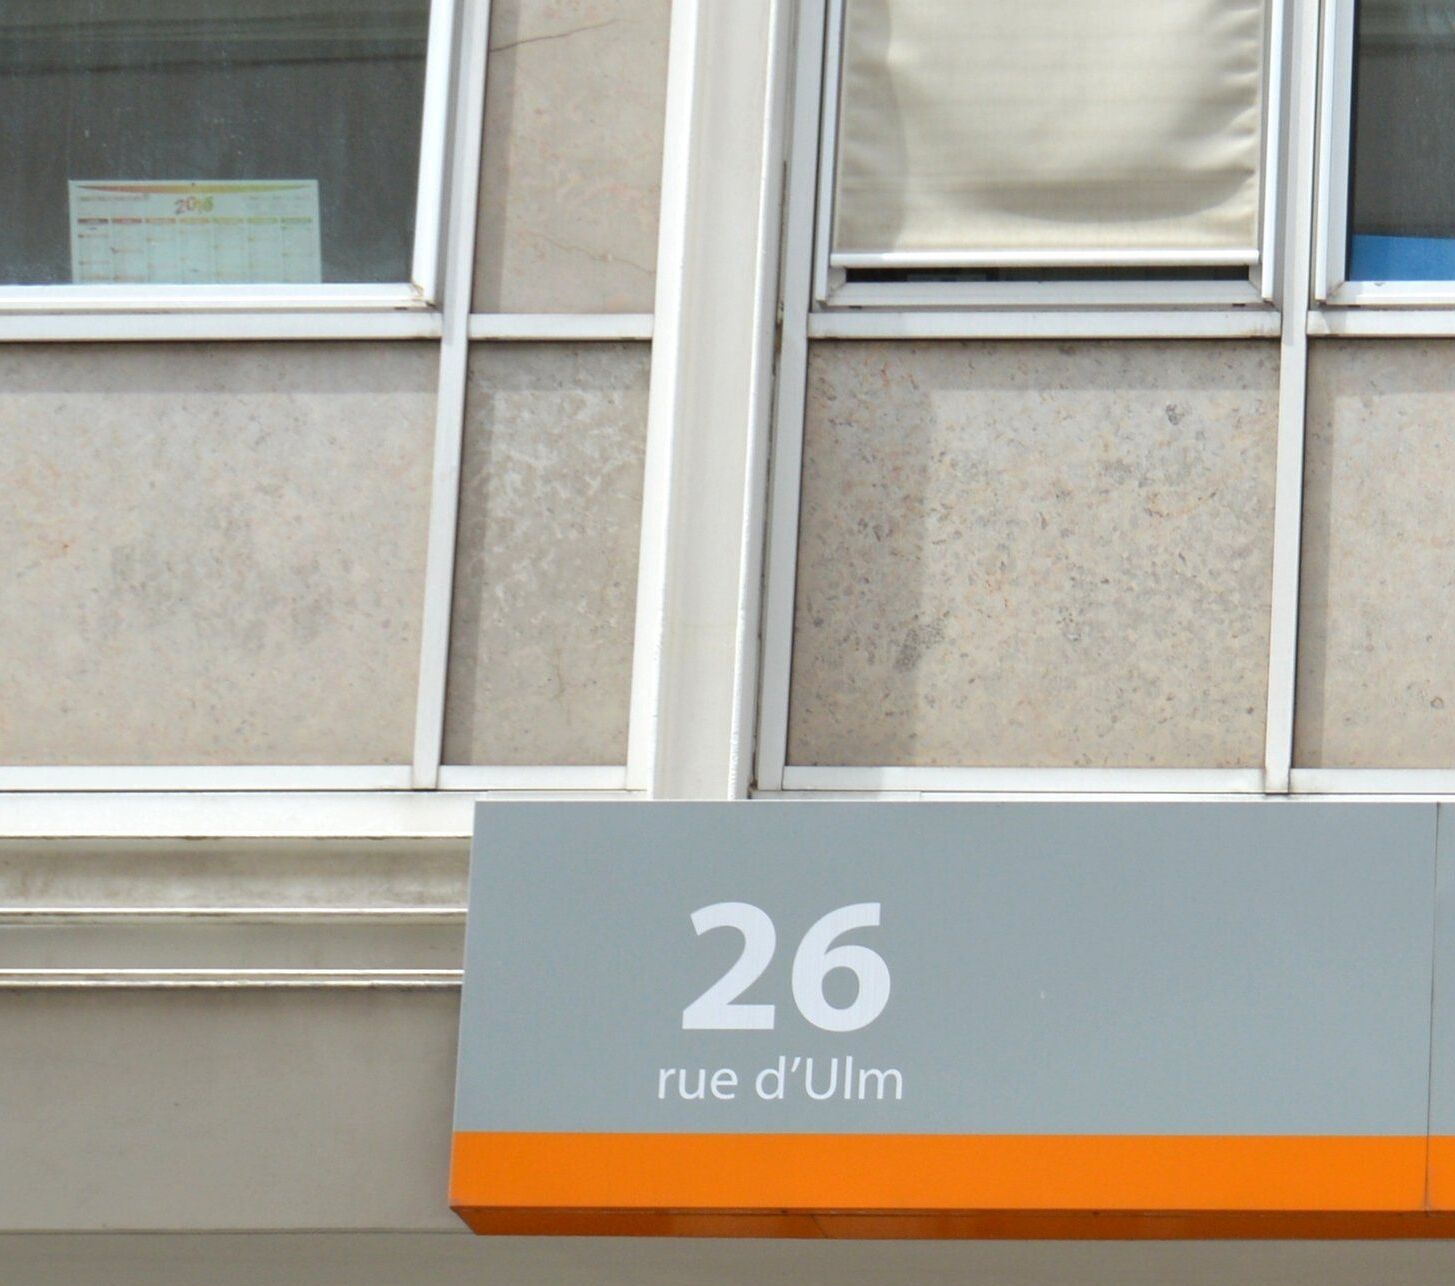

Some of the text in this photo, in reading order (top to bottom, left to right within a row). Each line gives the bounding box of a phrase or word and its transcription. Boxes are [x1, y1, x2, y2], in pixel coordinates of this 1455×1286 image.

[681, 901, 891, 1033] 26
[657, 1056, 903, 1100] rue d'Ulm
